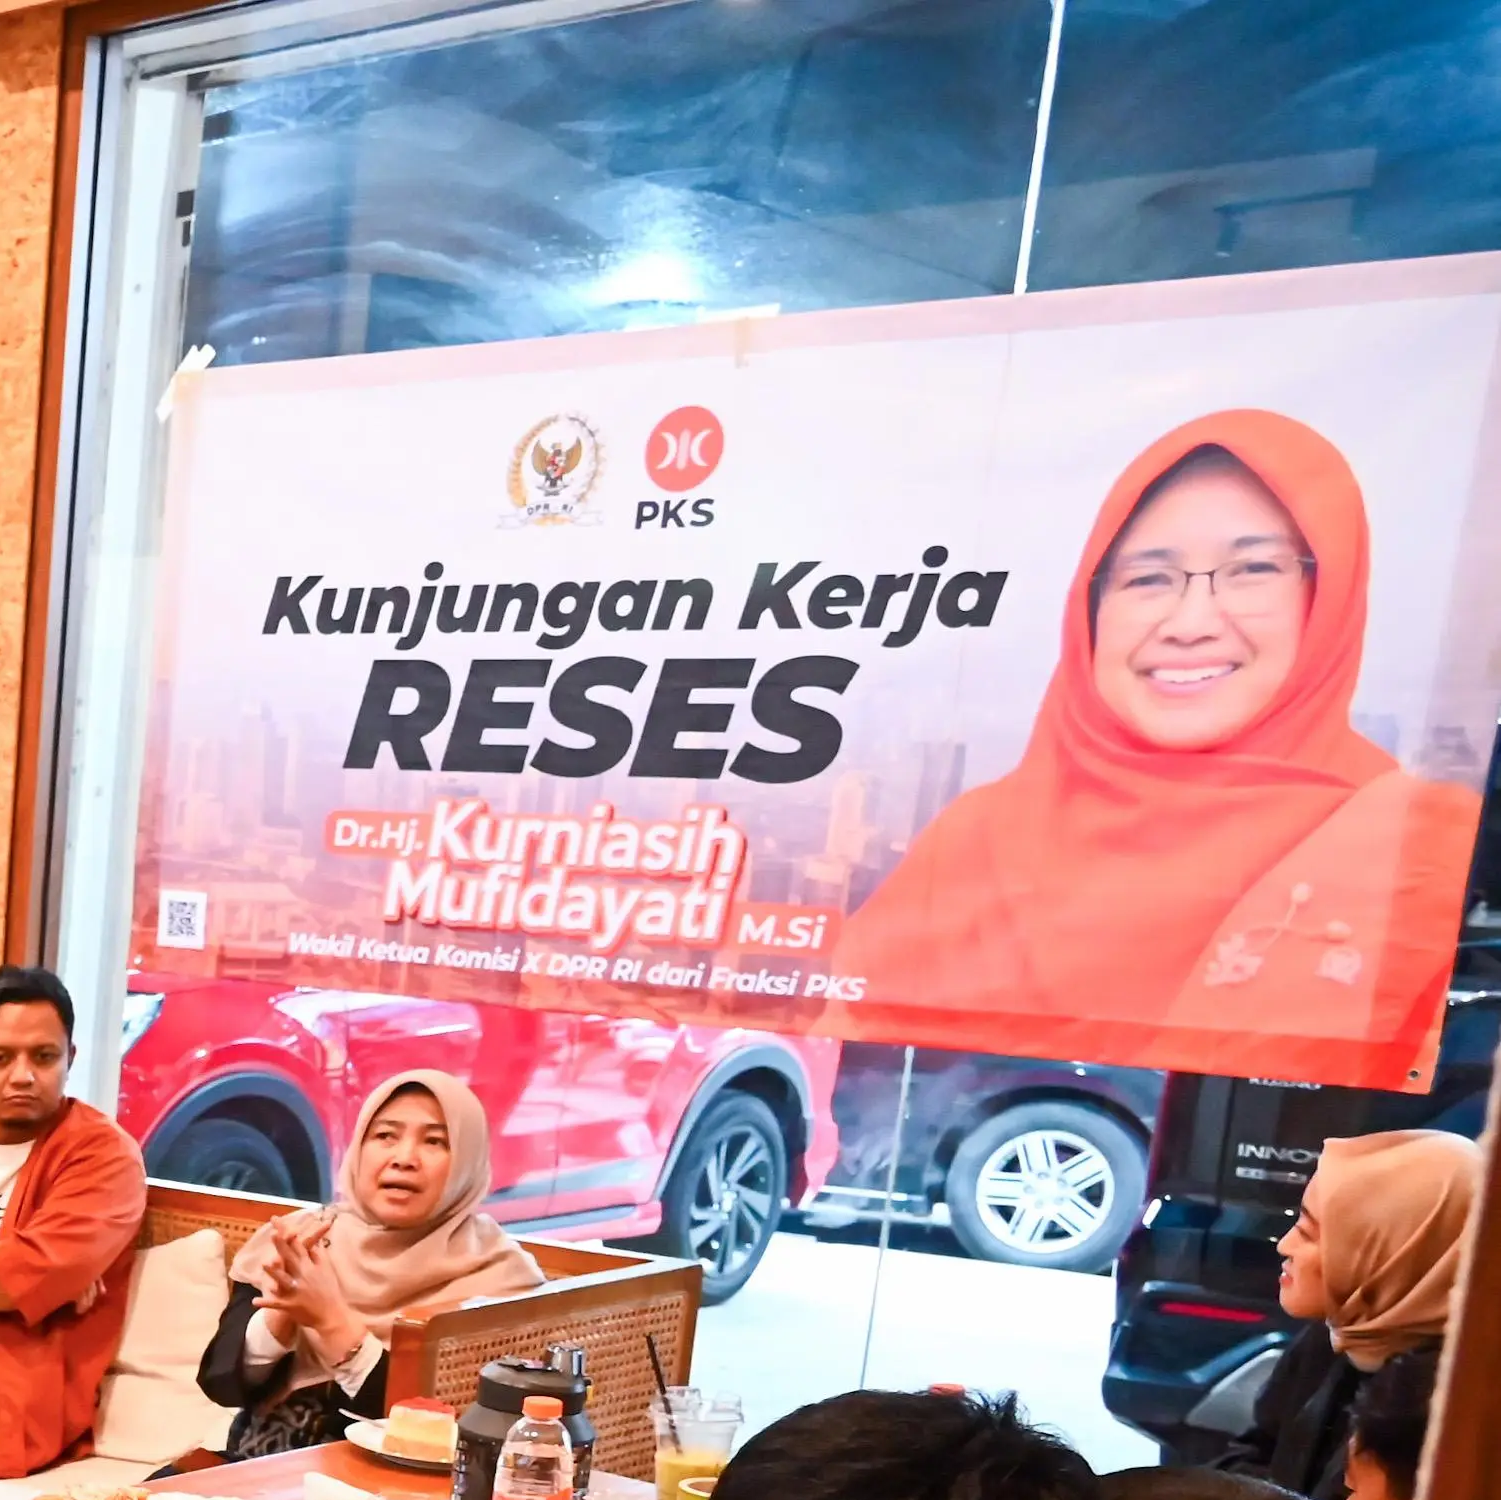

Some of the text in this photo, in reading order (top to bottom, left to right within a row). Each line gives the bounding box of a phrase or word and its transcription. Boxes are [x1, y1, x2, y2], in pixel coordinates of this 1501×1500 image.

[634, 498, 715, 530] PKS
[262, 545, 1010, 651] Kunjungan Kerja
[342, 655, 861, 784] RESES
[428, 800, 740, 877] Kurniasih
[385, 863, 828, 949] Mufidayati M.Si
[288, 932, 868, 1002] Wakil Ketua Komisi X DPR RI dari Fraksi PKS
